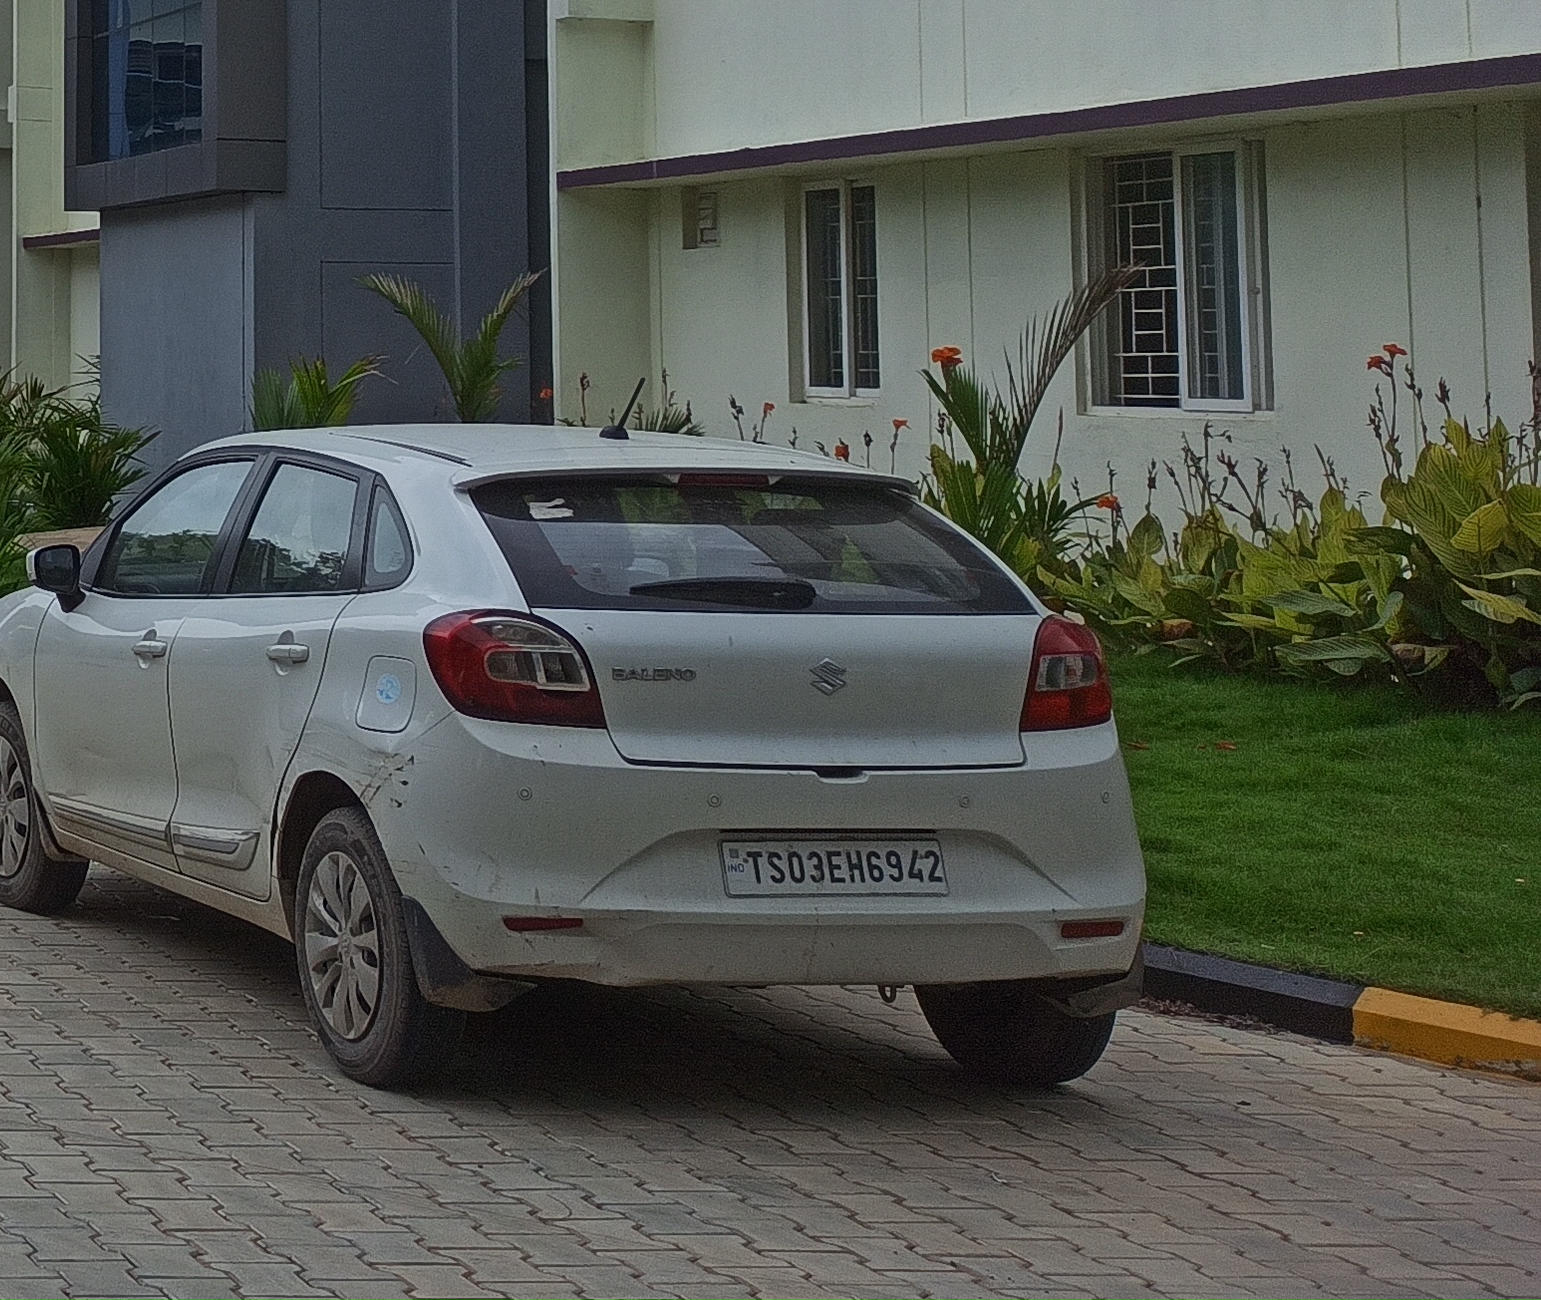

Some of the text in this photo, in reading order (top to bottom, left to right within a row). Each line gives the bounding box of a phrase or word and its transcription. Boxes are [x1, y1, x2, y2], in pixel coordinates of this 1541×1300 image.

[611, 666, 697, 681] BALENO
[727, 863, 745, 874] IND
[746, 849, 944, 884] TS03EH6942
